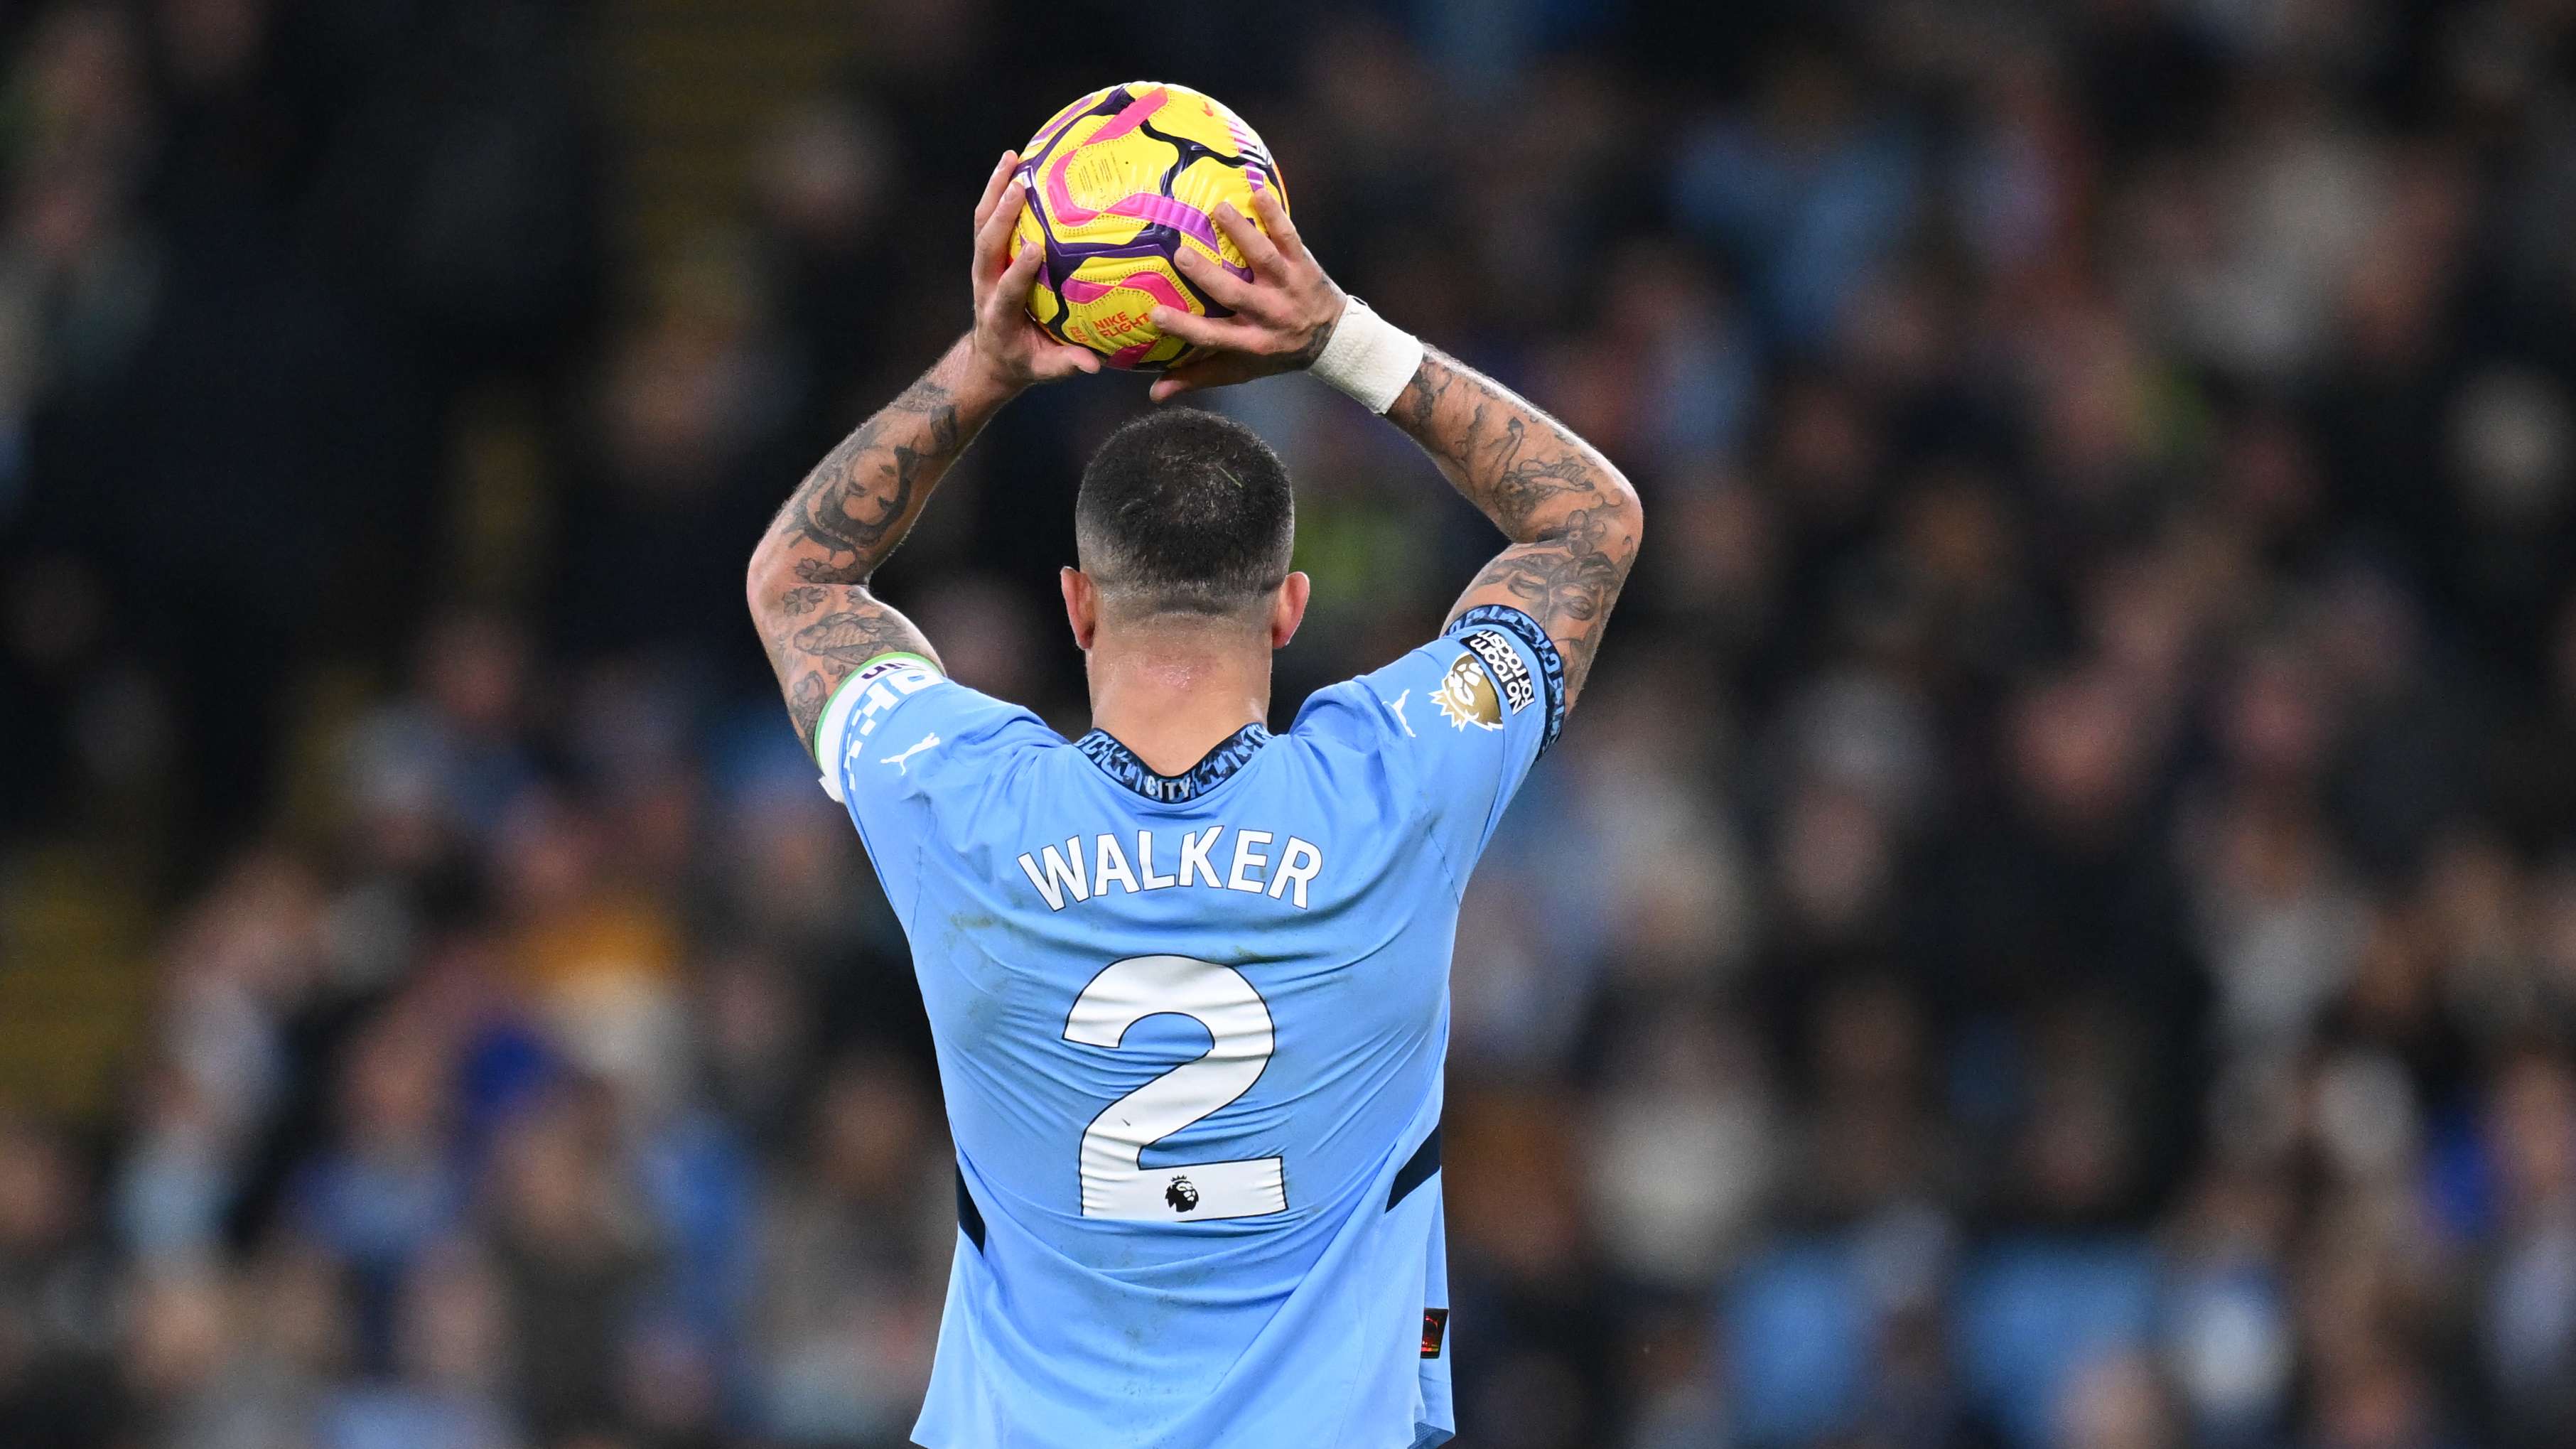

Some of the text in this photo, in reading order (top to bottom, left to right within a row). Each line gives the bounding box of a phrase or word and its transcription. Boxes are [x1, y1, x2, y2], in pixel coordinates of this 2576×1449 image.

[1092, 311, 1130, 330] NIKE
[1099, 312, 1150, 337] FLIGHT
[1470, 638, 1522, 716] No room
[1477, 630, 1527, 677] racism
[1145, 775, 1191, 800] CITY
[1018, 824, 1323, 912] WALKER
[1062, 953, 1289, 1222] 2
